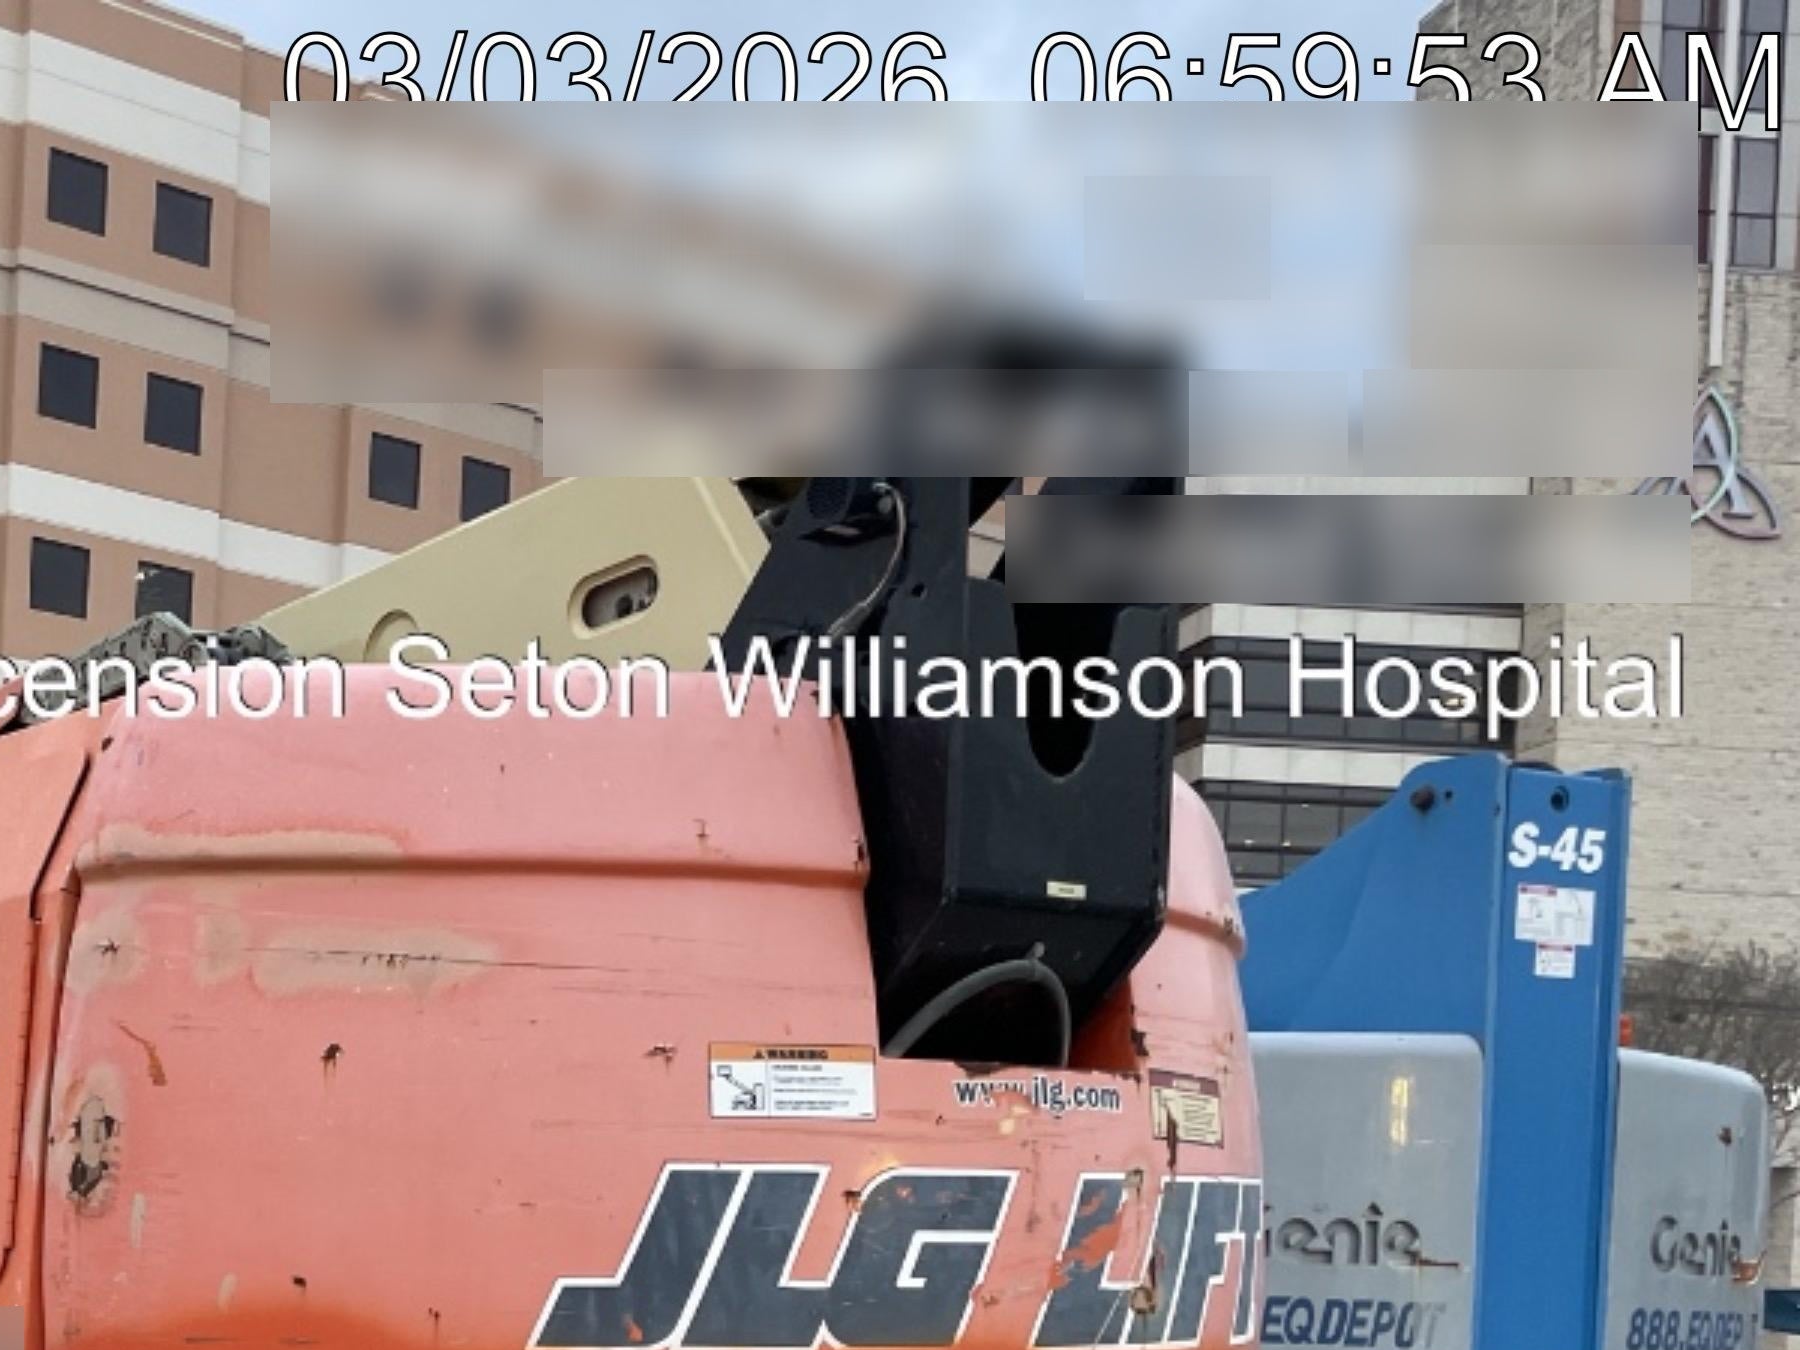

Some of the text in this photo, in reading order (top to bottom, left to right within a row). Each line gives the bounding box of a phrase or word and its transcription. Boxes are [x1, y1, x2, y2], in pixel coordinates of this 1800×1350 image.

[1508, 821, 1607, 874] S-45
[952, 1076, 1121, 1113] wwjlg.com
[1263, 1201, 1422, 1267] enie
[1651, 1214, 1742, 1283] Genie
